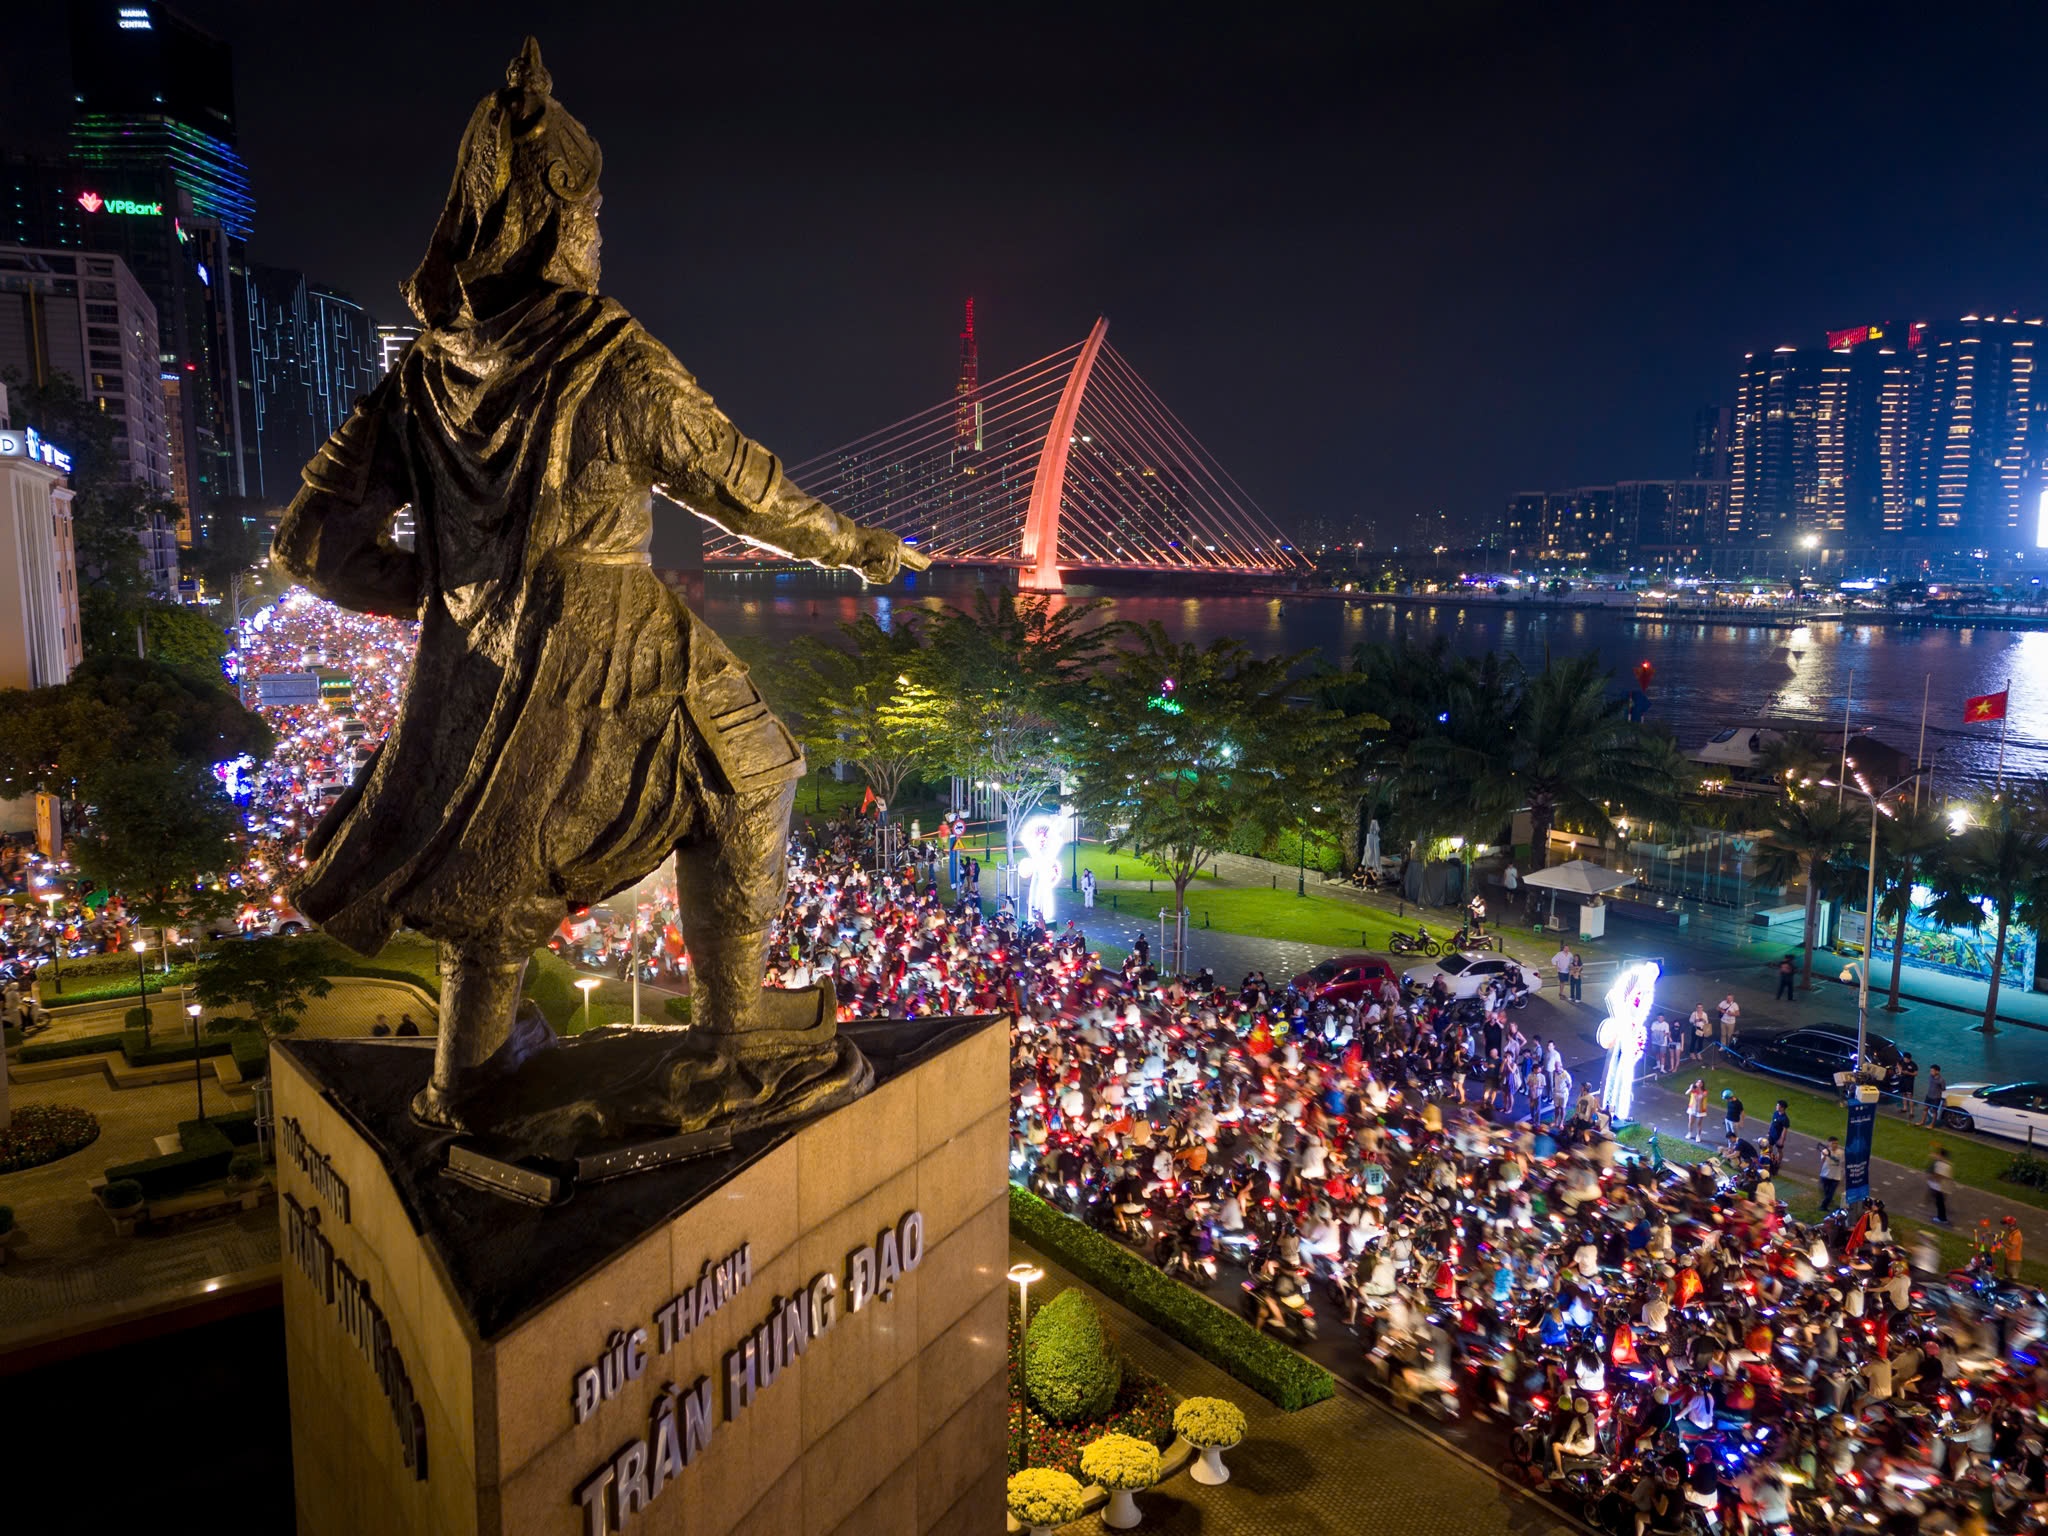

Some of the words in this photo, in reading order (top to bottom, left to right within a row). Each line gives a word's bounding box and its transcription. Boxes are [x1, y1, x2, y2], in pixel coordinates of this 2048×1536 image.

[120, 9, 149, 17] MARINA
[119, 20, 152, 29] CENTRAL
[103, 199, 164, 216] VPBank
[572, 1327, 648, 1425] ĐỨC
[653, 1241, 752, 1356] THÁNH
[572, 1374, 713, 1536] TRẦN
[722, 1270, 837, 1423] HƯNG
[843, 1209, 925, 1314] ĐẠO
